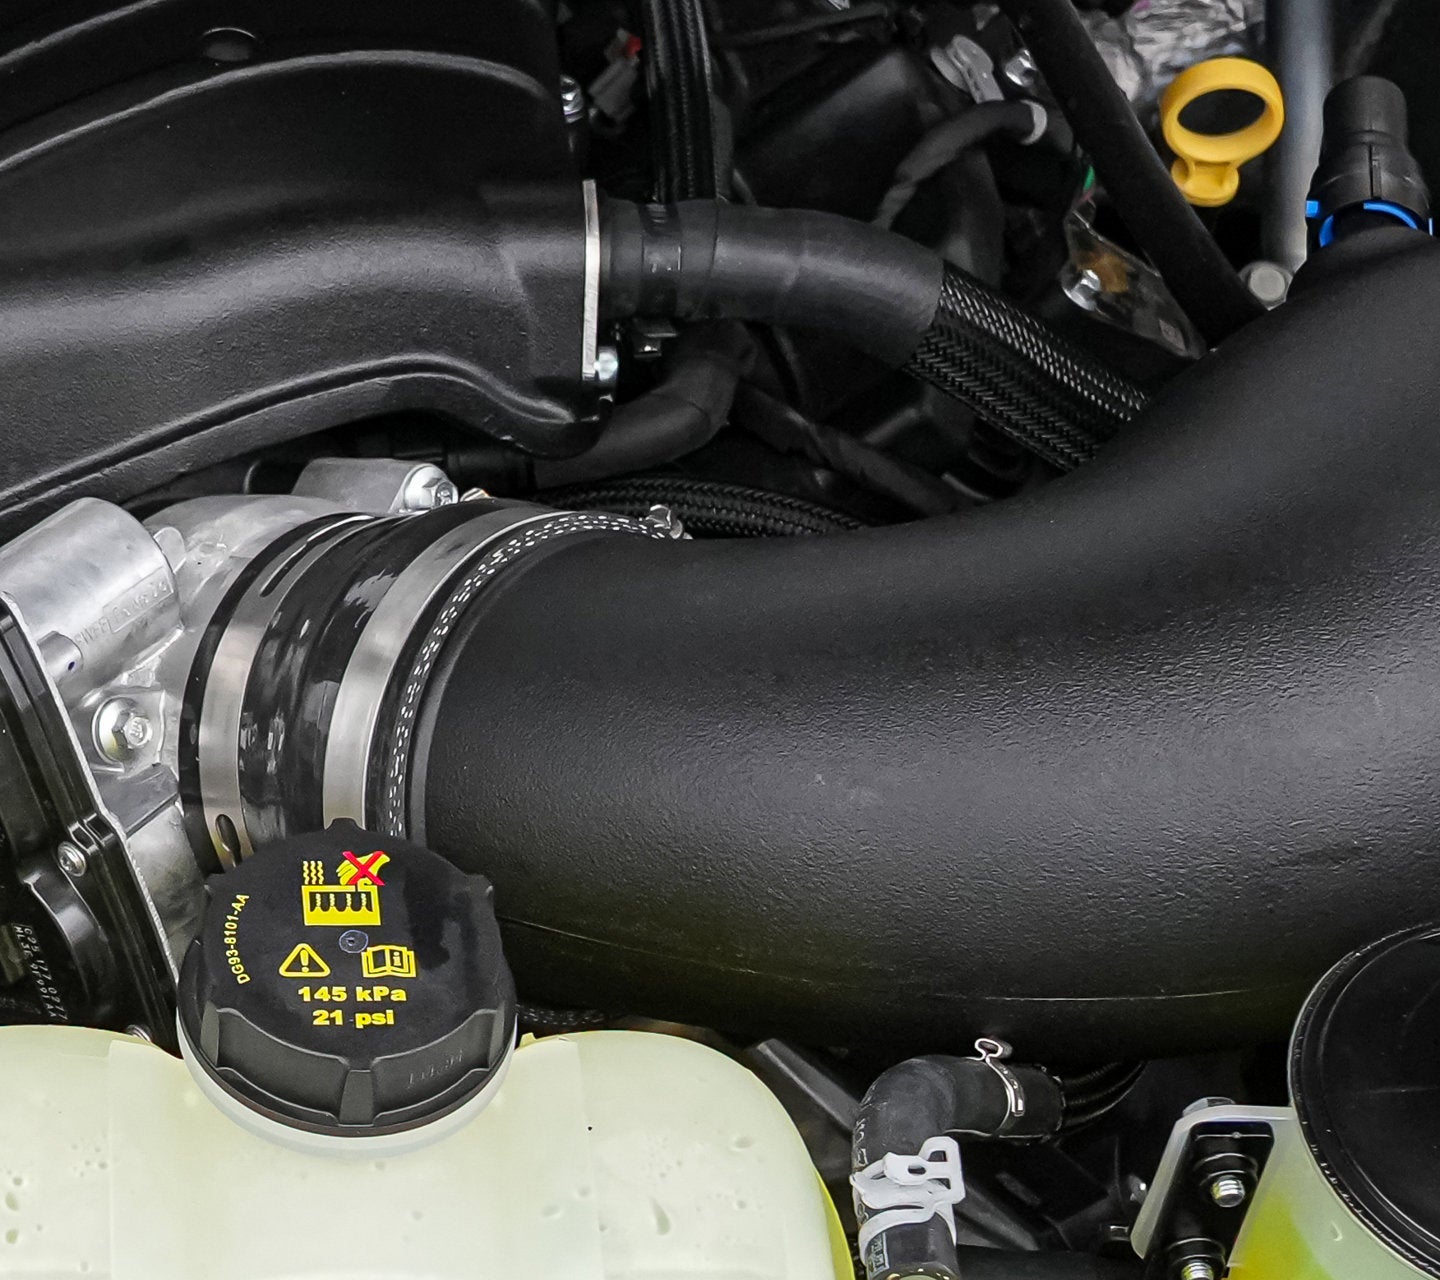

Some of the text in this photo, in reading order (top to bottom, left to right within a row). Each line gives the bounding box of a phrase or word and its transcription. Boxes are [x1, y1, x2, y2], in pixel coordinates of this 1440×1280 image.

[224, 894, 251, 985] DG93-8101-AA
[298, 986, 407, 1002] 145 kPa
[312, 1009, 395, 1029] 21 psi
